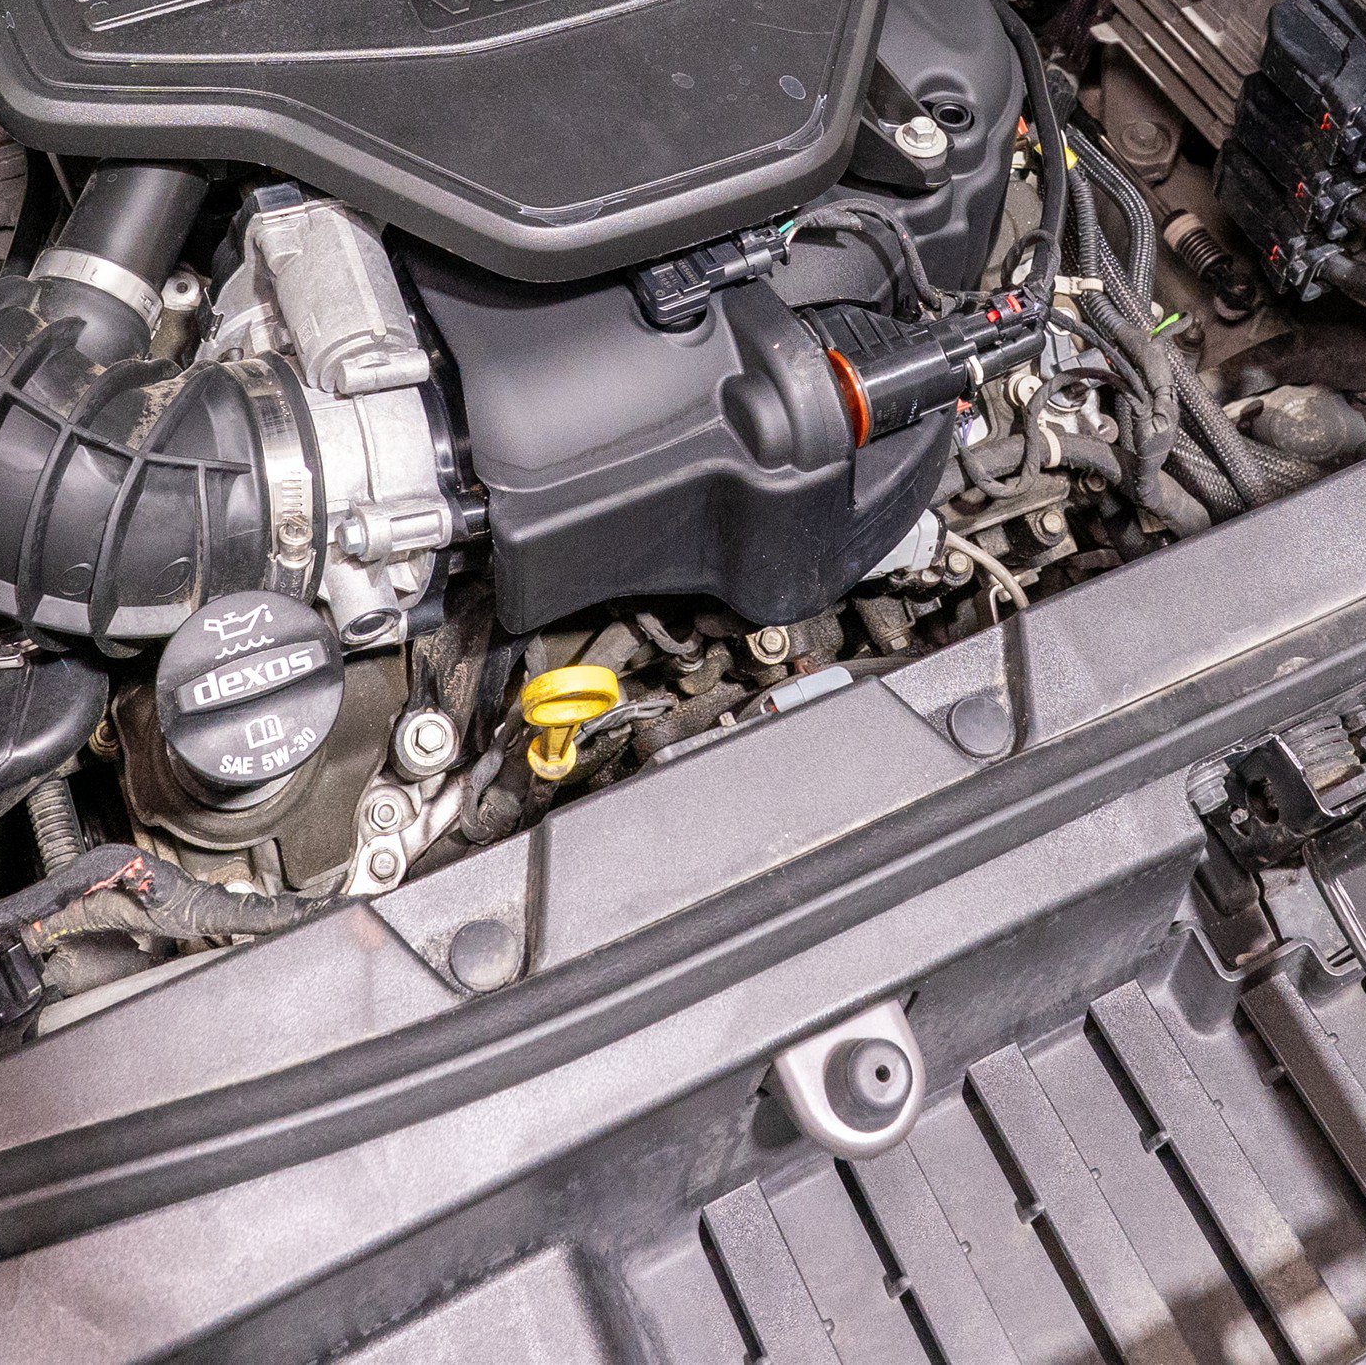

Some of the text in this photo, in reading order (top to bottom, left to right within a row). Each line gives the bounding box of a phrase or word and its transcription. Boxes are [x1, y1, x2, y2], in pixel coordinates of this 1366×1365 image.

[193, 649, 314, 705] dexos
[219, 726, 317, 775] SAE 5W-30
